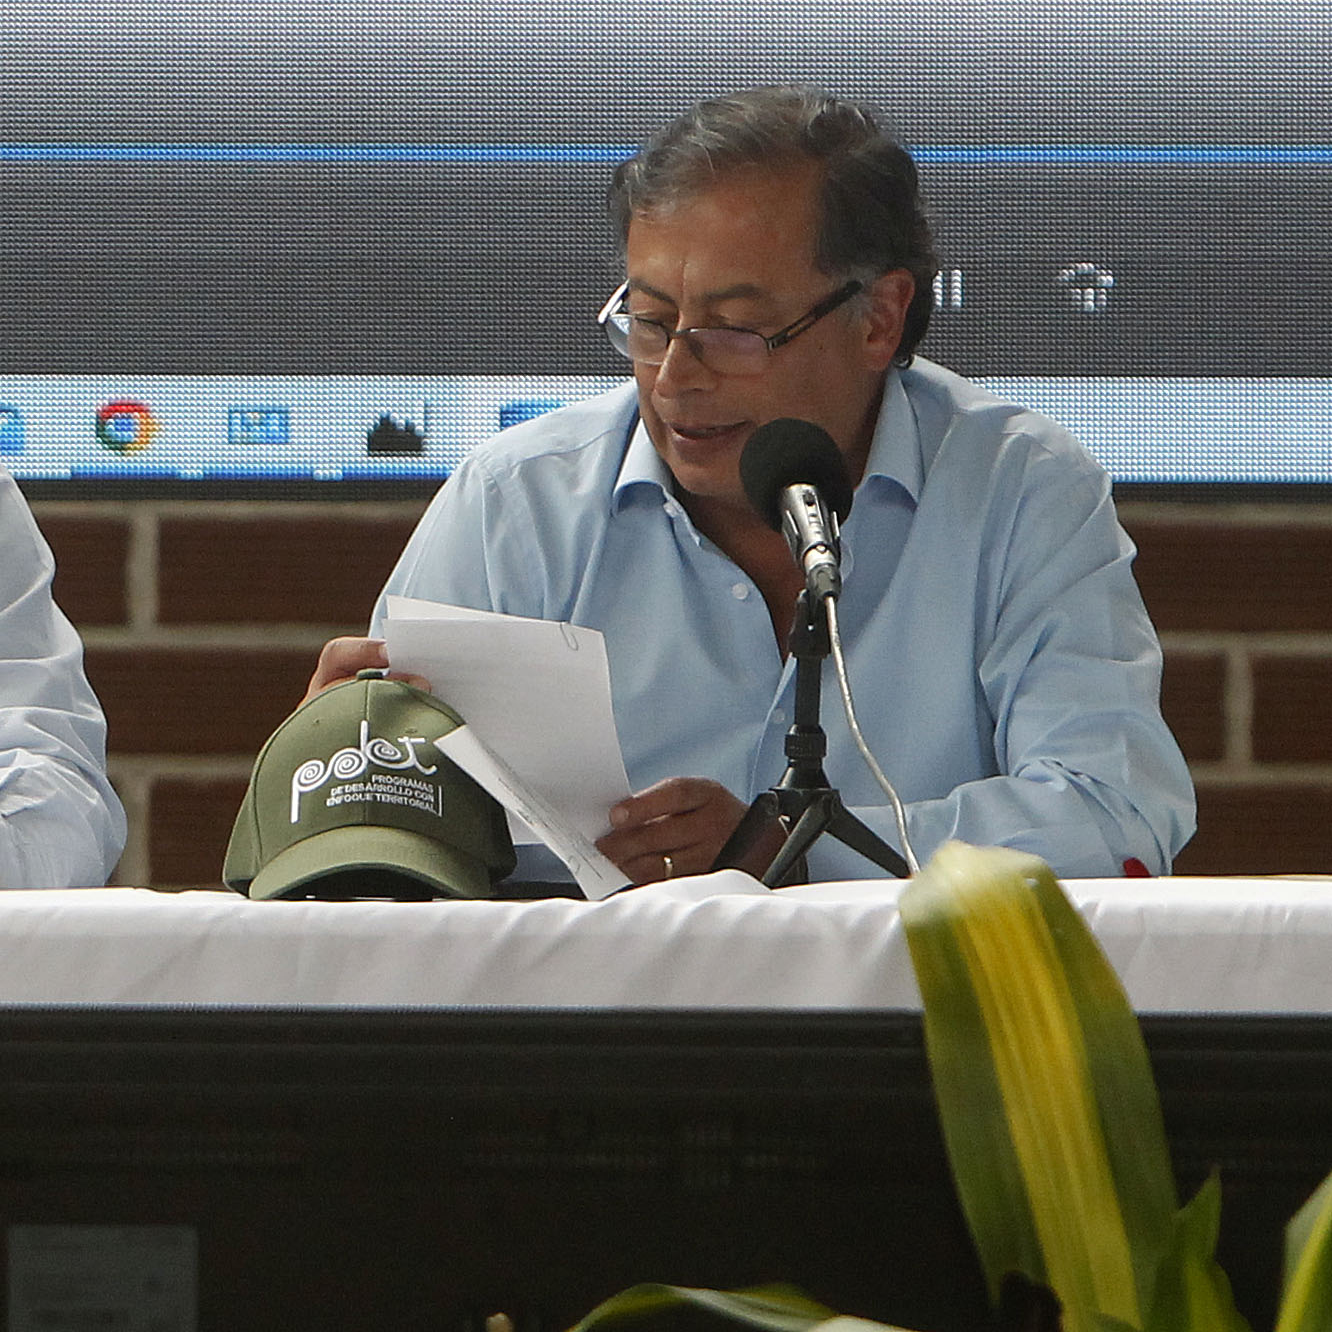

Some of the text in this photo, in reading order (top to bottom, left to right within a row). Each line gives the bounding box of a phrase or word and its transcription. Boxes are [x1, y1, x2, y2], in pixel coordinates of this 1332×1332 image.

[371, 774, 434, 794] PROGRAMAS
[326, 792, 373, 807] ENFOQUE
[413, 789, 434, 803] CON
